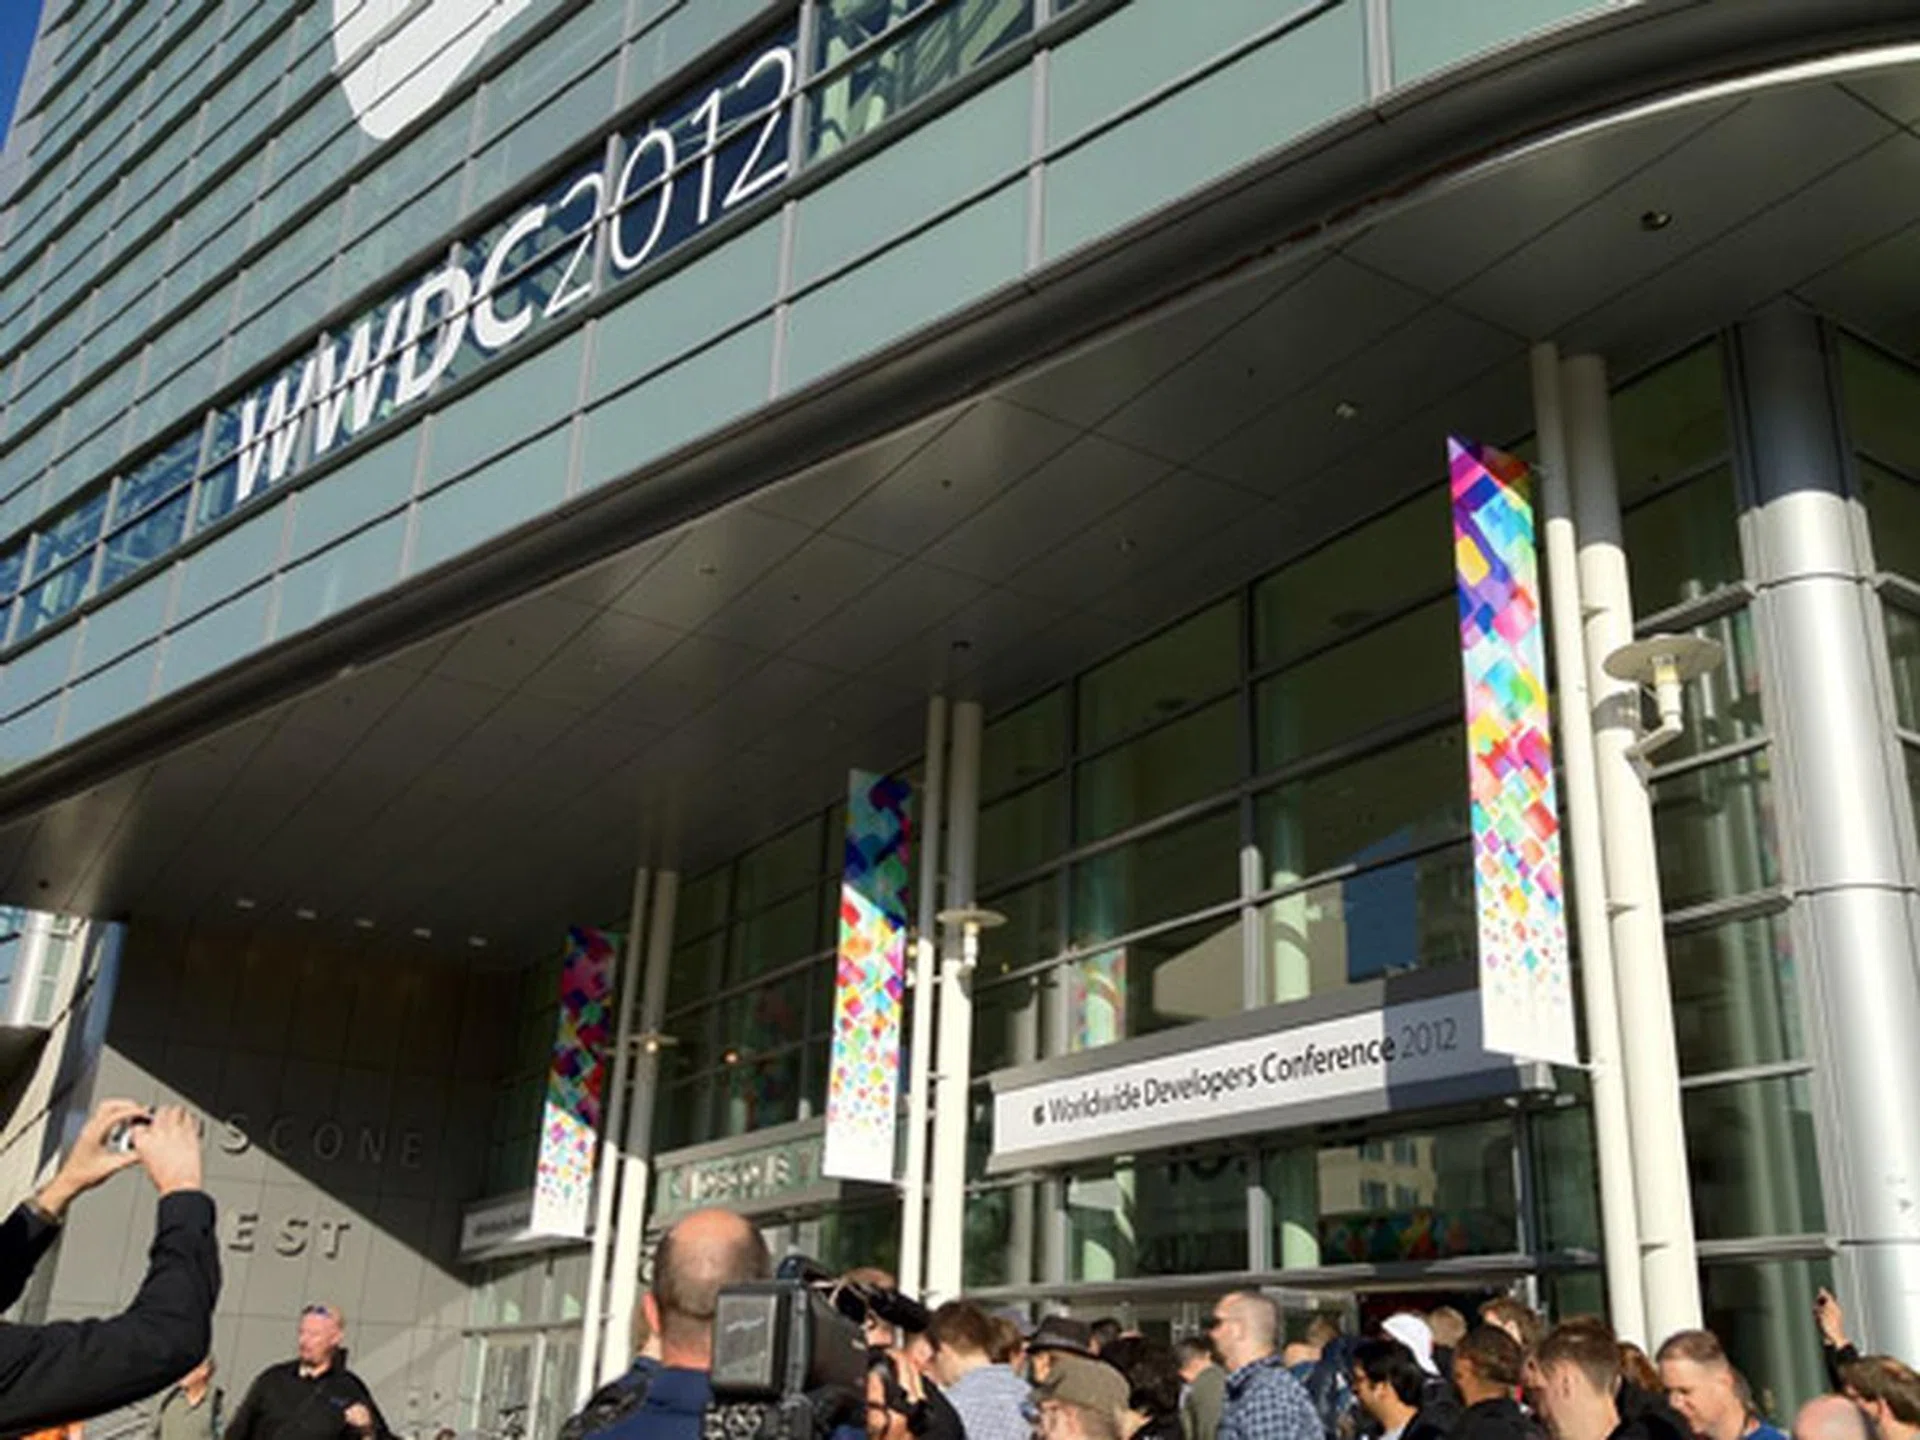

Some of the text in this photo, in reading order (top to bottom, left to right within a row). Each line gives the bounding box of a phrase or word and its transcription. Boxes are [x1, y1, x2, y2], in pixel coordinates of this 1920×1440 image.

[1049, 1017, 1457, 1123] Worldwide Developers Conference 2012
[197, 1113, 424, 1169] SCONE
[226, 1211, 352, 1261] EST
